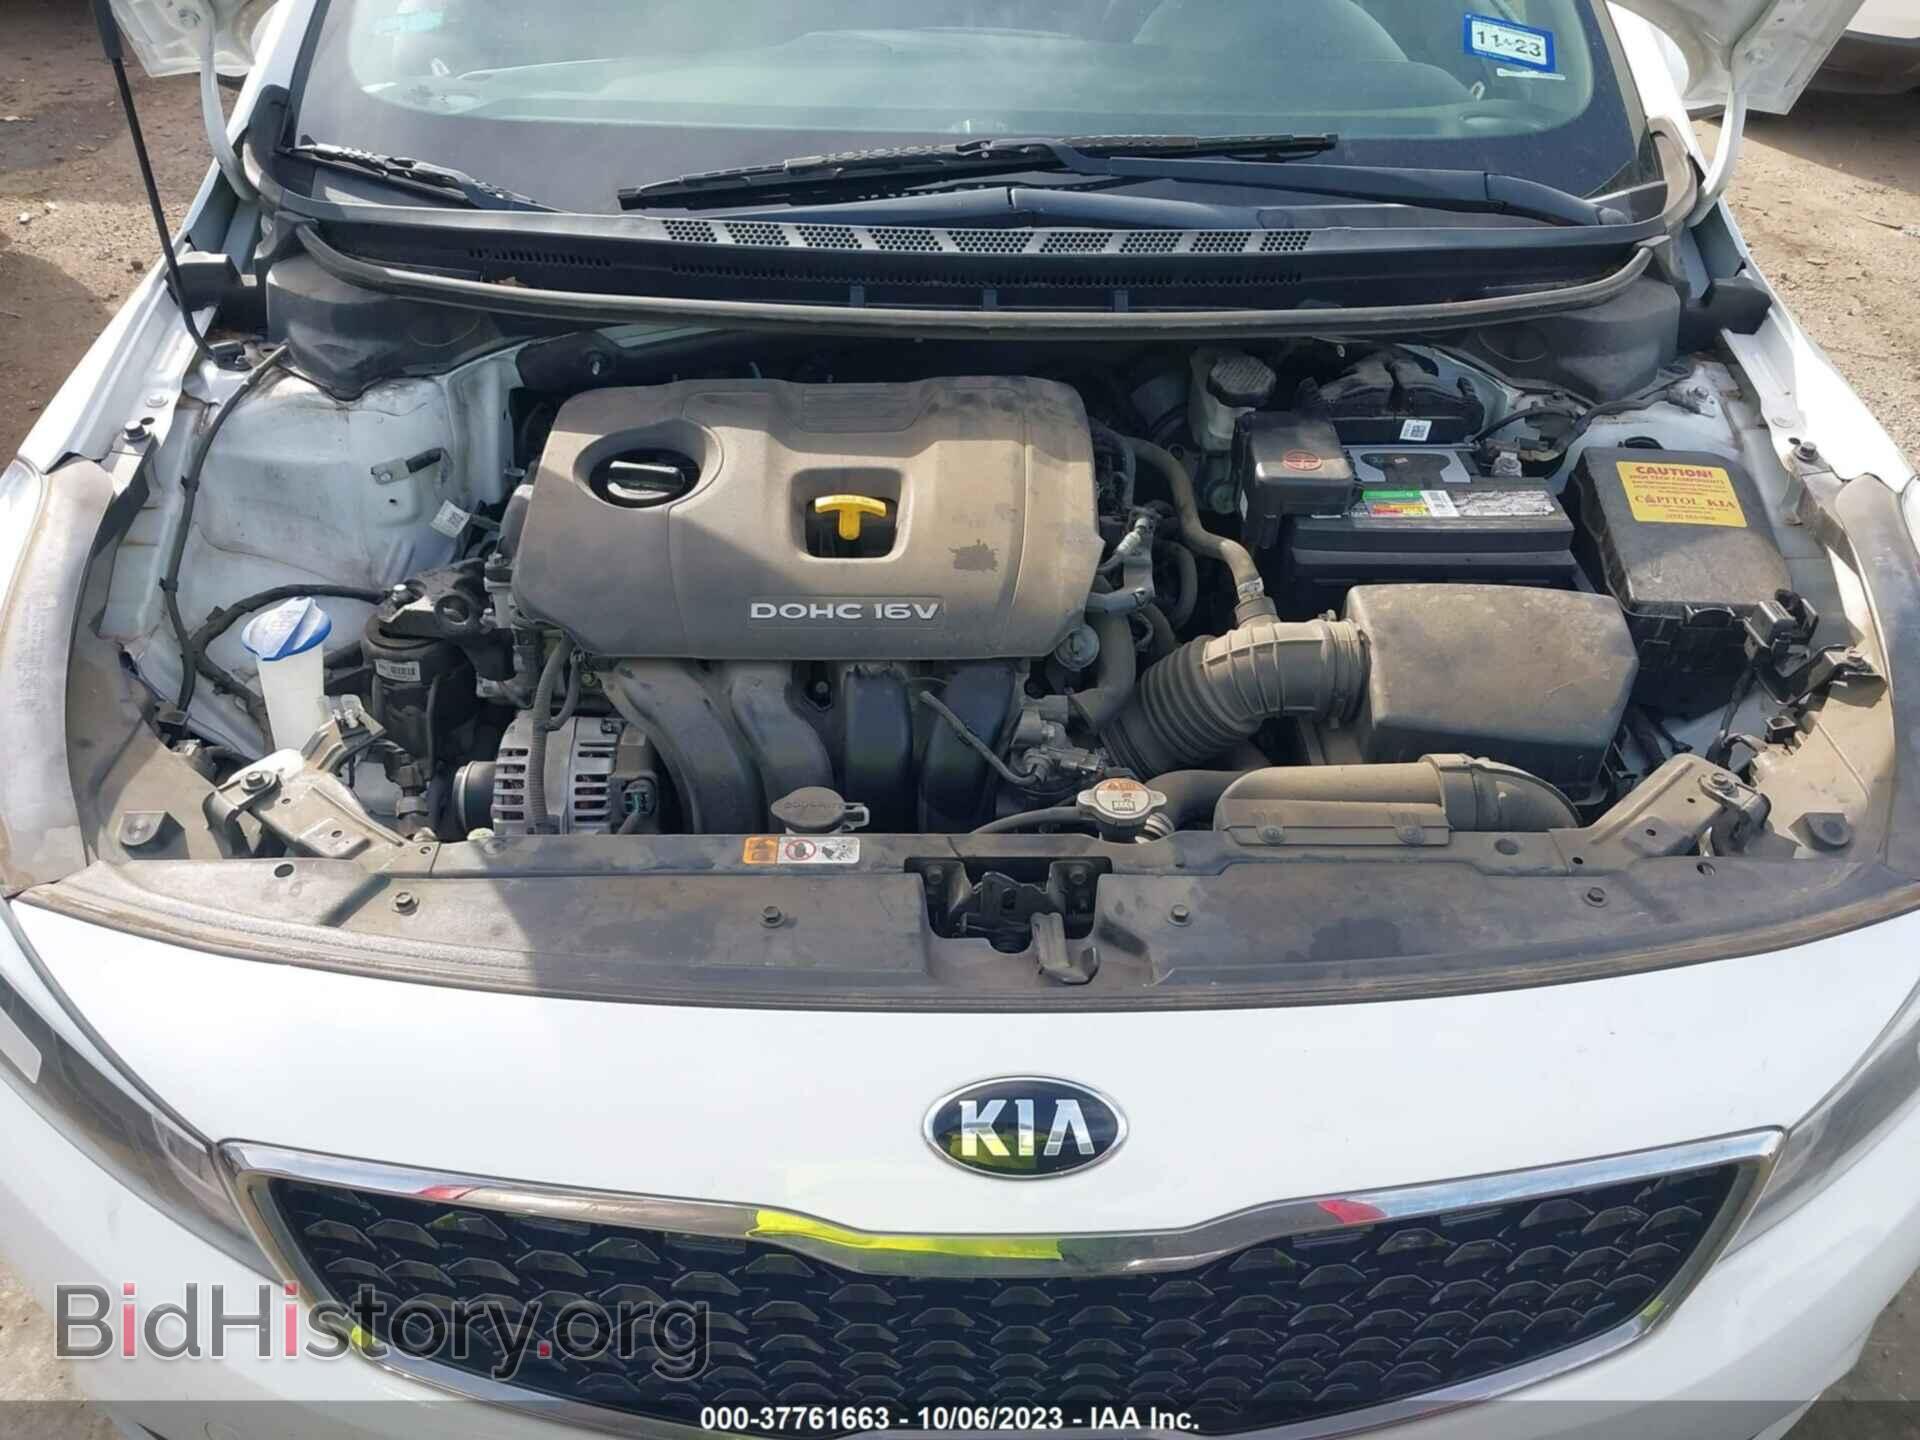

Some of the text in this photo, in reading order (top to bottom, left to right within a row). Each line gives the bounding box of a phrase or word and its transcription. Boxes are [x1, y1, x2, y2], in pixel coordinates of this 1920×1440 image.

[1515, 38, 1542, 58] 23
[1635, 466, 1713, 478] CAUTION!
[1706, 498, 1736, 510] KIA
[750, 602, 940, 620] DOHC 16V
[958, 1098, 1096, 1157] KIA
